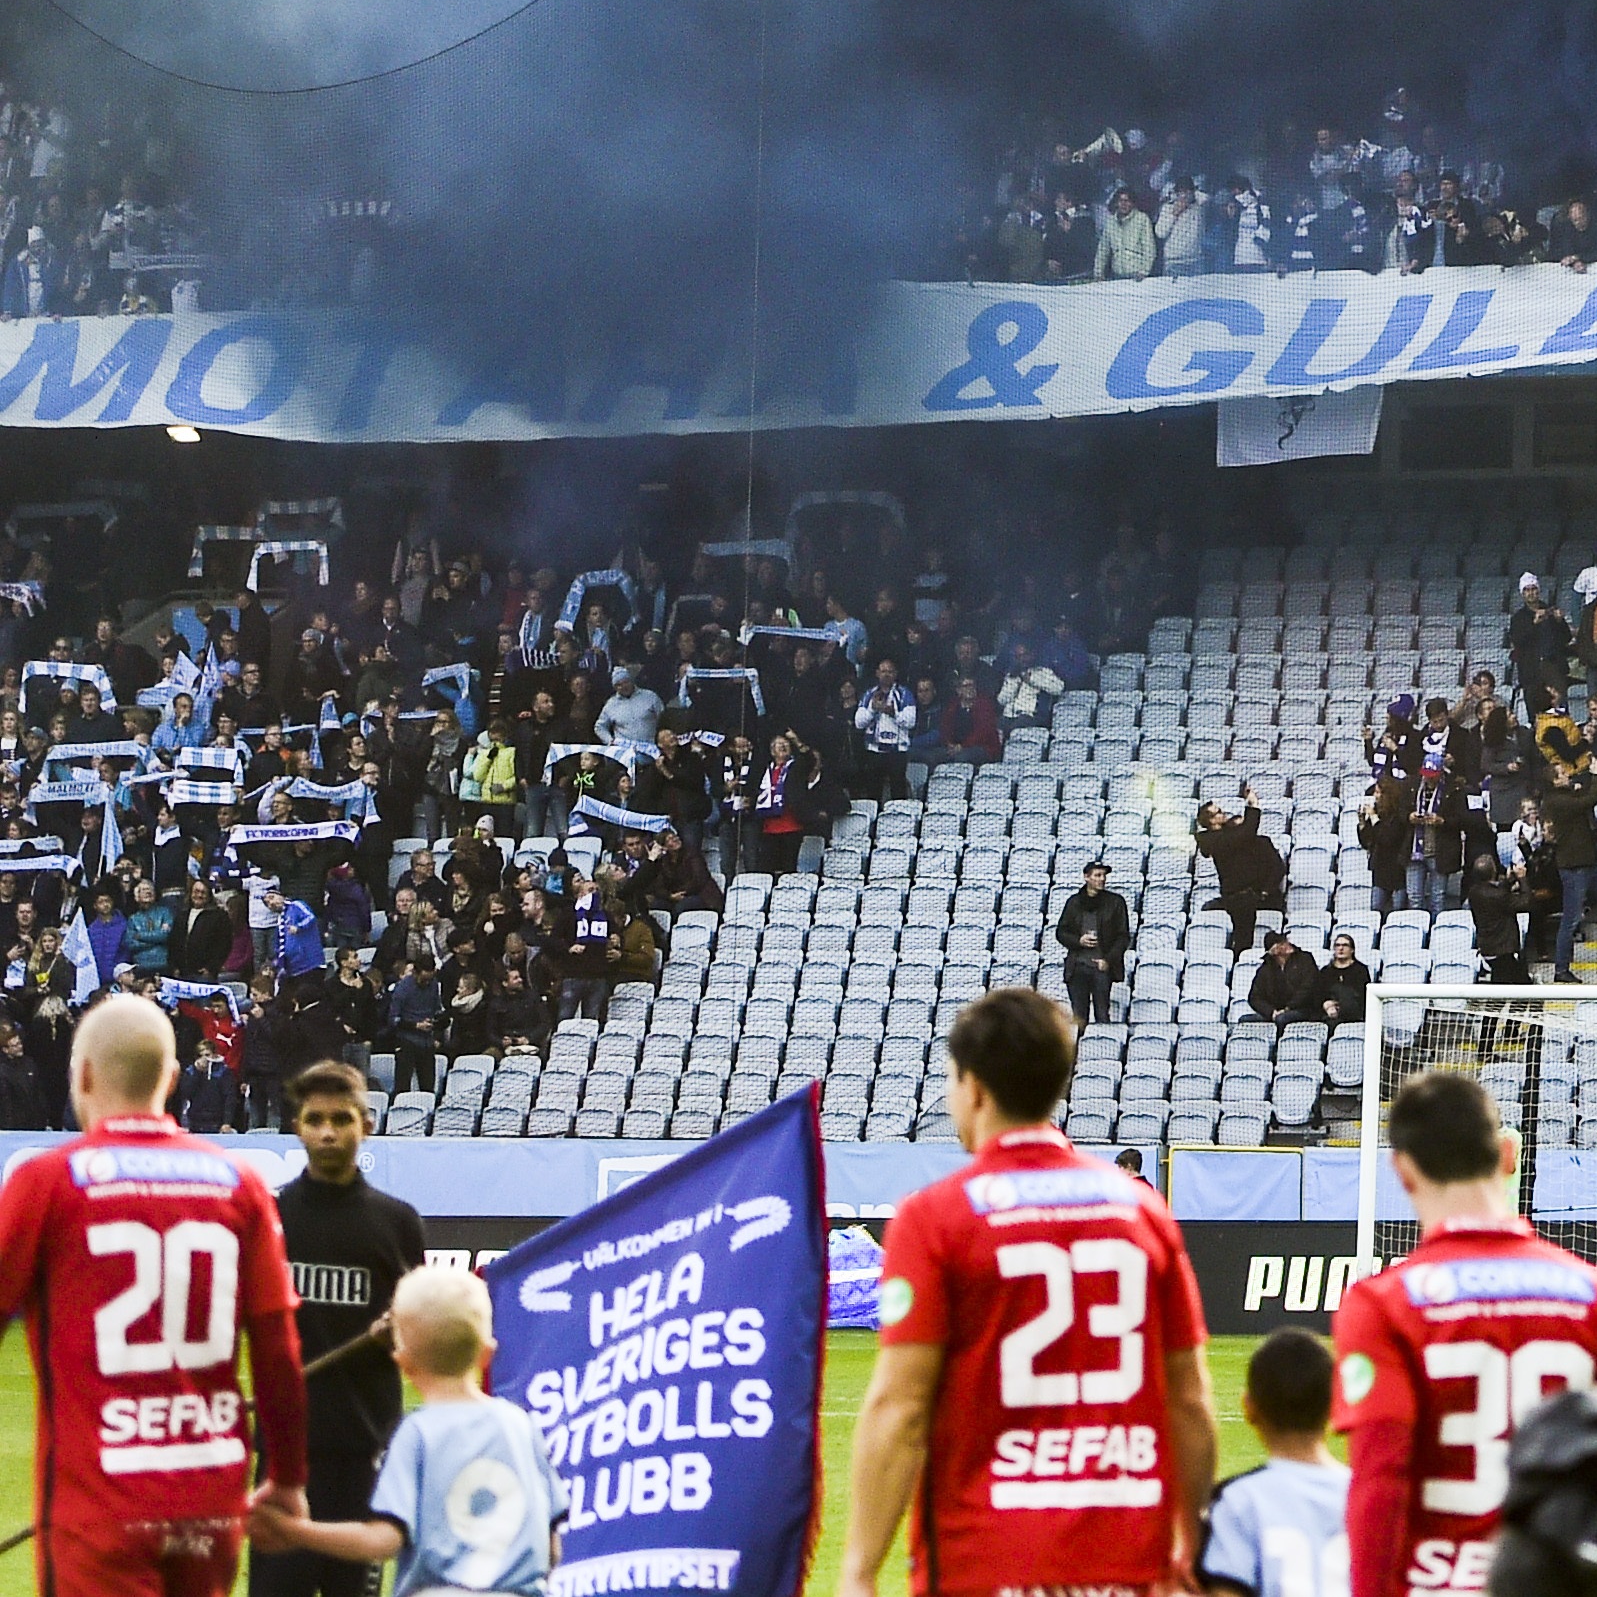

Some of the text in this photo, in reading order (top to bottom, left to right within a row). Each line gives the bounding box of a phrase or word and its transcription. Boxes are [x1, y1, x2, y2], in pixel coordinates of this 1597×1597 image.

[923, 301, 1057, 411] &
[86, 1220, 240, 1377] 20
[288, 1262, 371, 1306] UMA
[588, 1251, 706, 1349] HELA
[996, 1238, 1148, 1409] 23
[99, 1389, 241, 1444] SEFAB
[526, 1307, 767, 1430] SVERIGES
[990, 1425, 1158, 1478] SEFAB
